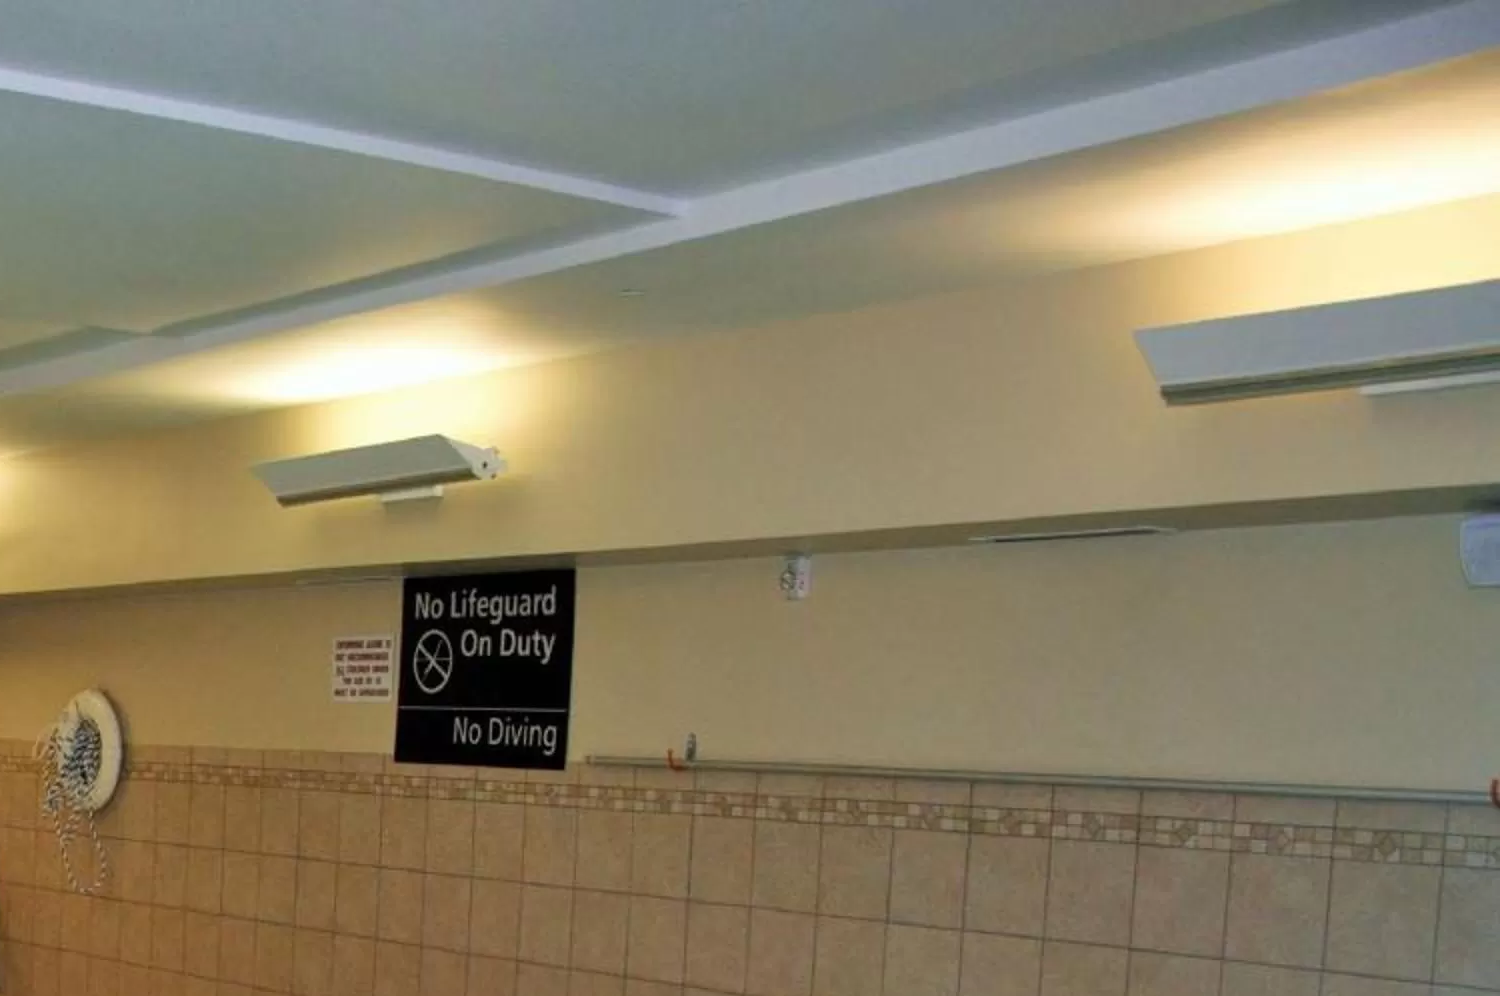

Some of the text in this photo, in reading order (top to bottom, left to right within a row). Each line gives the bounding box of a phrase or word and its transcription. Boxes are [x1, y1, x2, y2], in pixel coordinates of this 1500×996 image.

[415, 584, 557, 625] No Lifeguard
[461, 628, 556, 665] On Duty
[452, 716, 557, 756] No Diving
